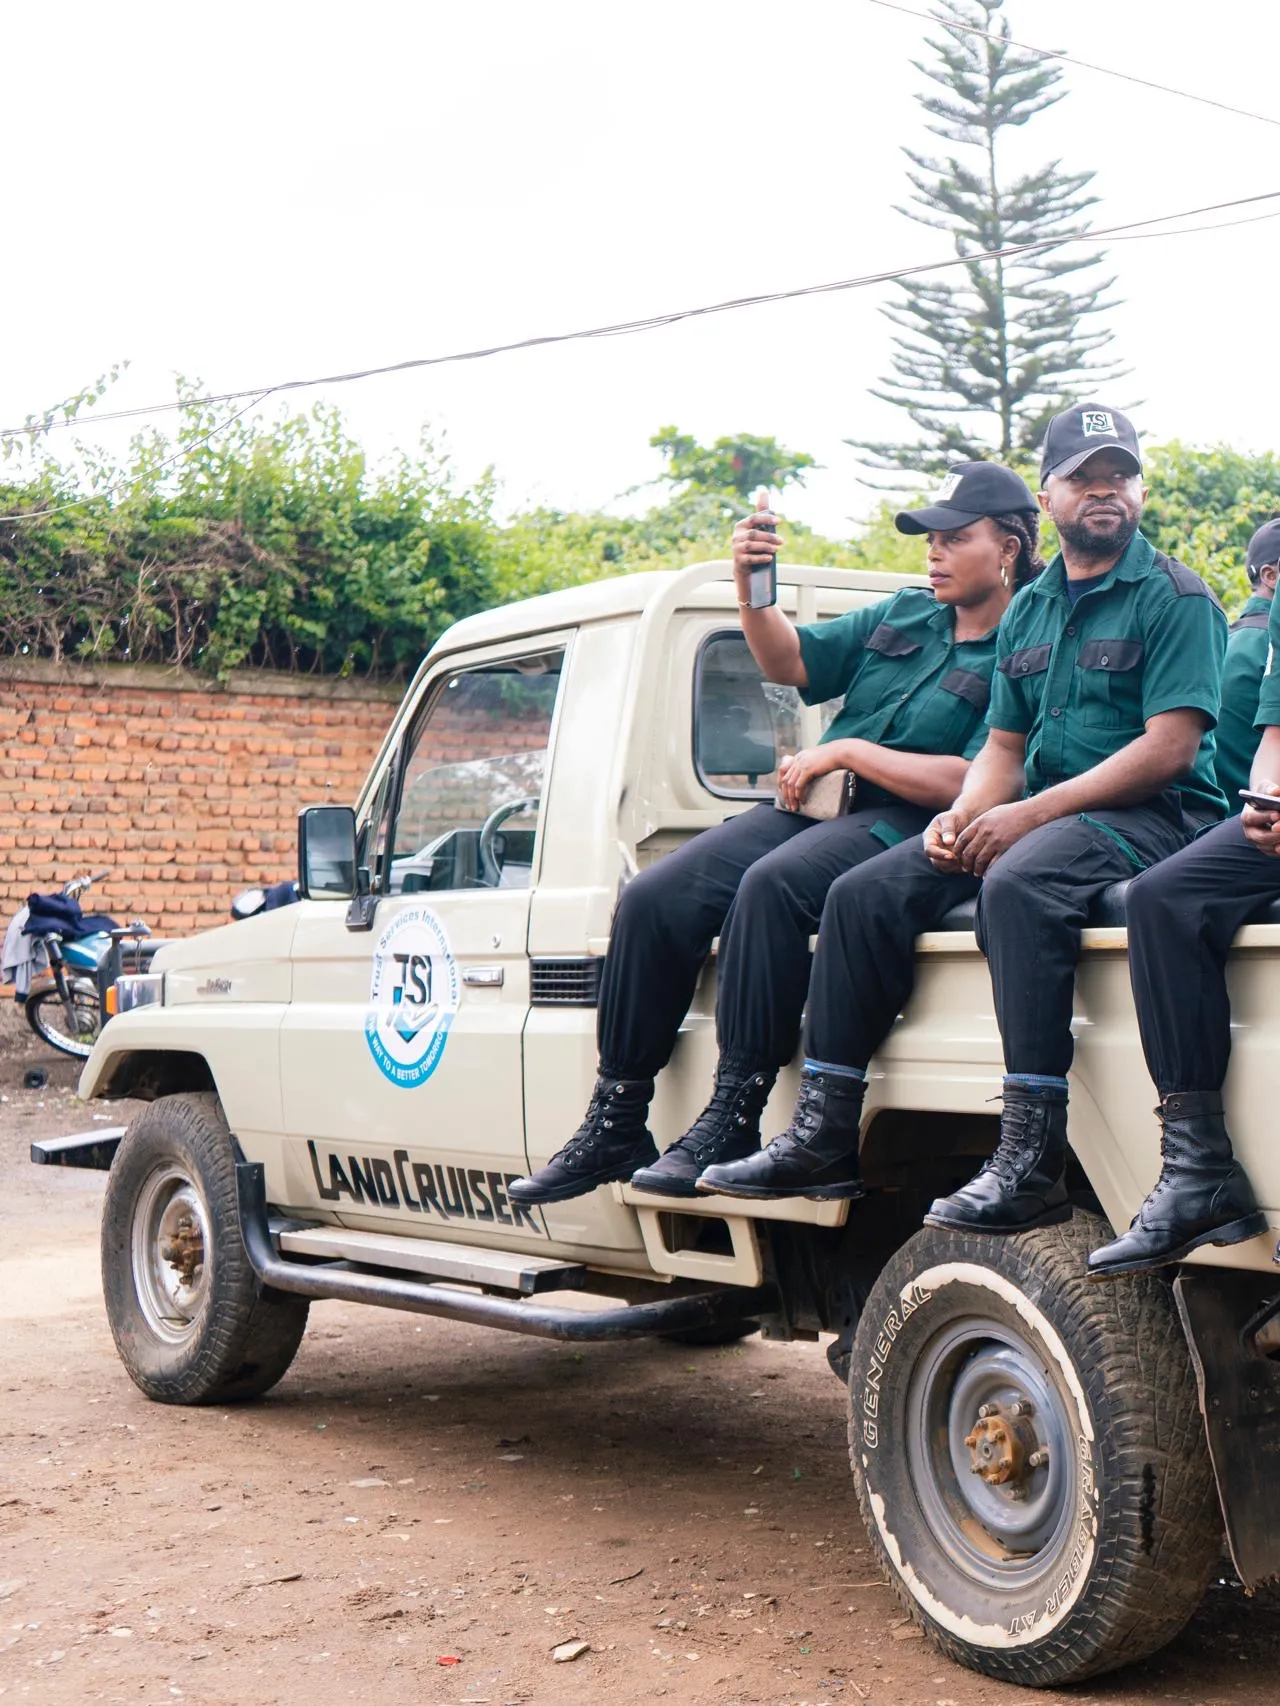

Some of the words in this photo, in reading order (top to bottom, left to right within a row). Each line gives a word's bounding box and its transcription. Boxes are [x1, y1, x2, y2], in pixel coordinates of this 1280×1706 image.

[380, 911, 420, 949] Services
[392, 952, 433, 1006] TSI
[372, 1036, 384, 1059] WAY
[383, 1055, 392, 1072] TO
[396, 1067, 421, 1081] BETTER
[863, 1284, 932, 1449] GENERAL
[1045, 1433, 1095, 1618] GRABBER
[1007, 1609, 1037, 1637] AT
